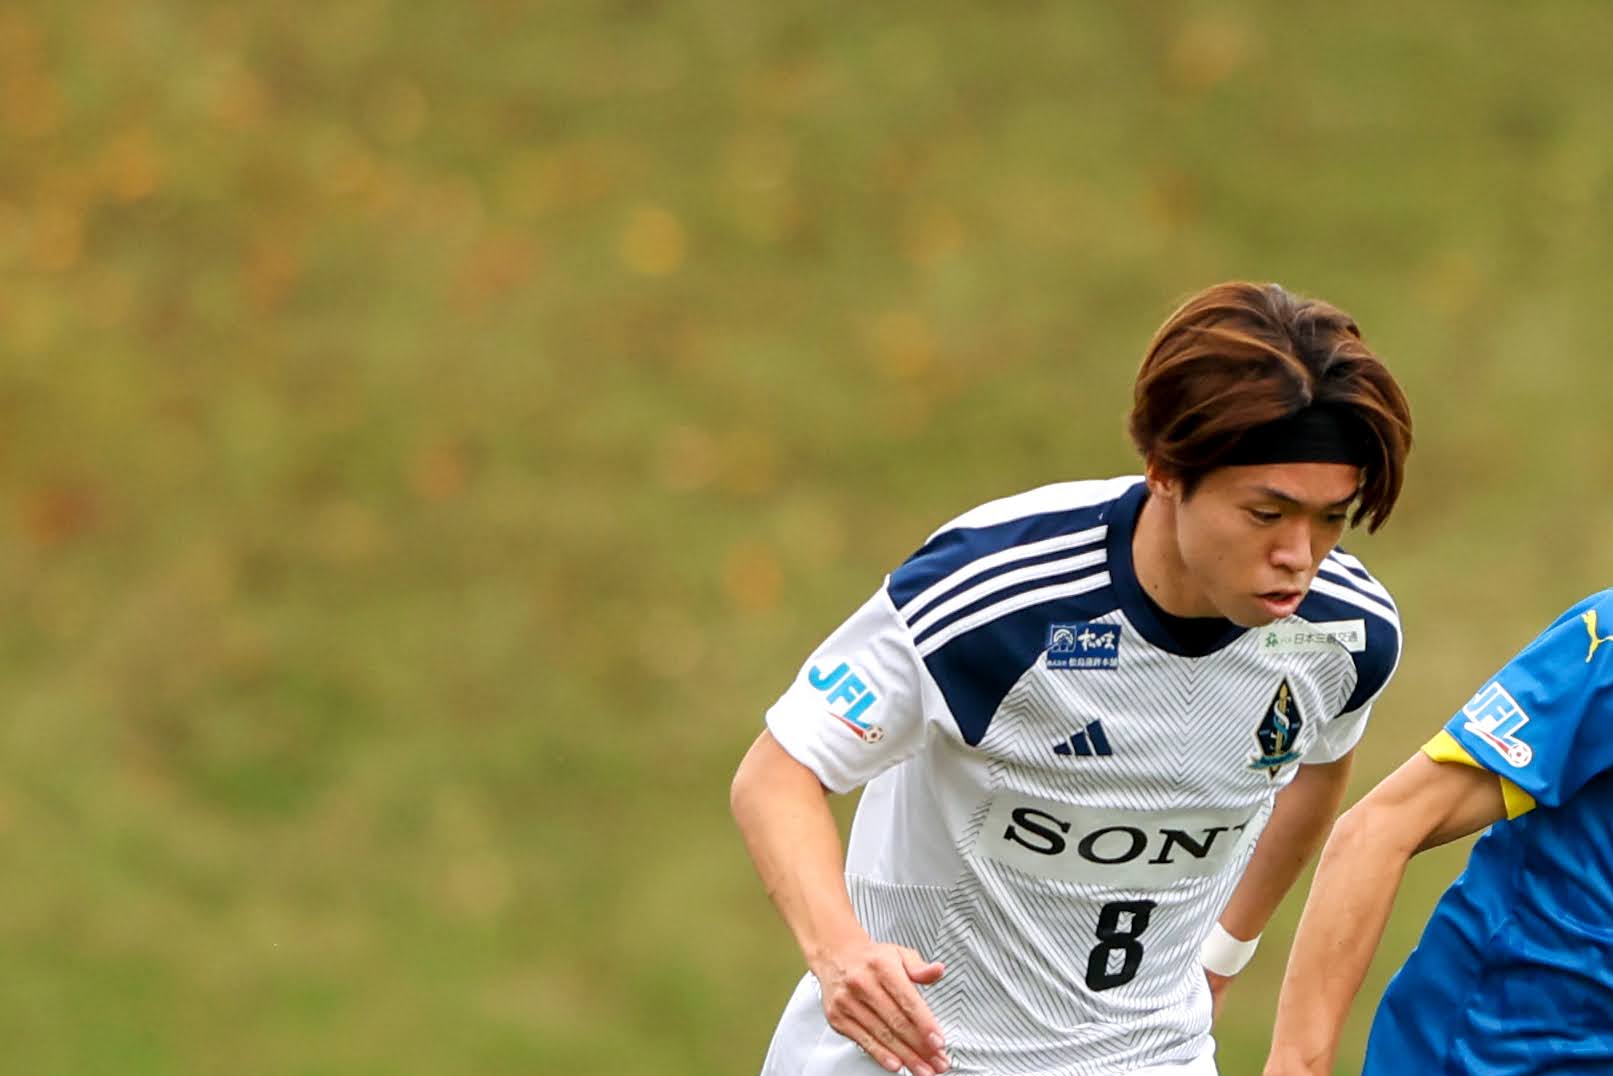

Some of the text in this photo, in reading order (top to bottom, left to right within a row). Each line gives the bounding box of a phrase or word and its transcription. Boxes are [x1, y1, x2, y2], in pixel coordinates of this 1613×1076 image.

[808, 662, 877, 729] JFL
[1466, 685, 1525, 748] JFL
[1003, 807, 1248, 865] SON
[1085, 899, 1158, 992] 8
